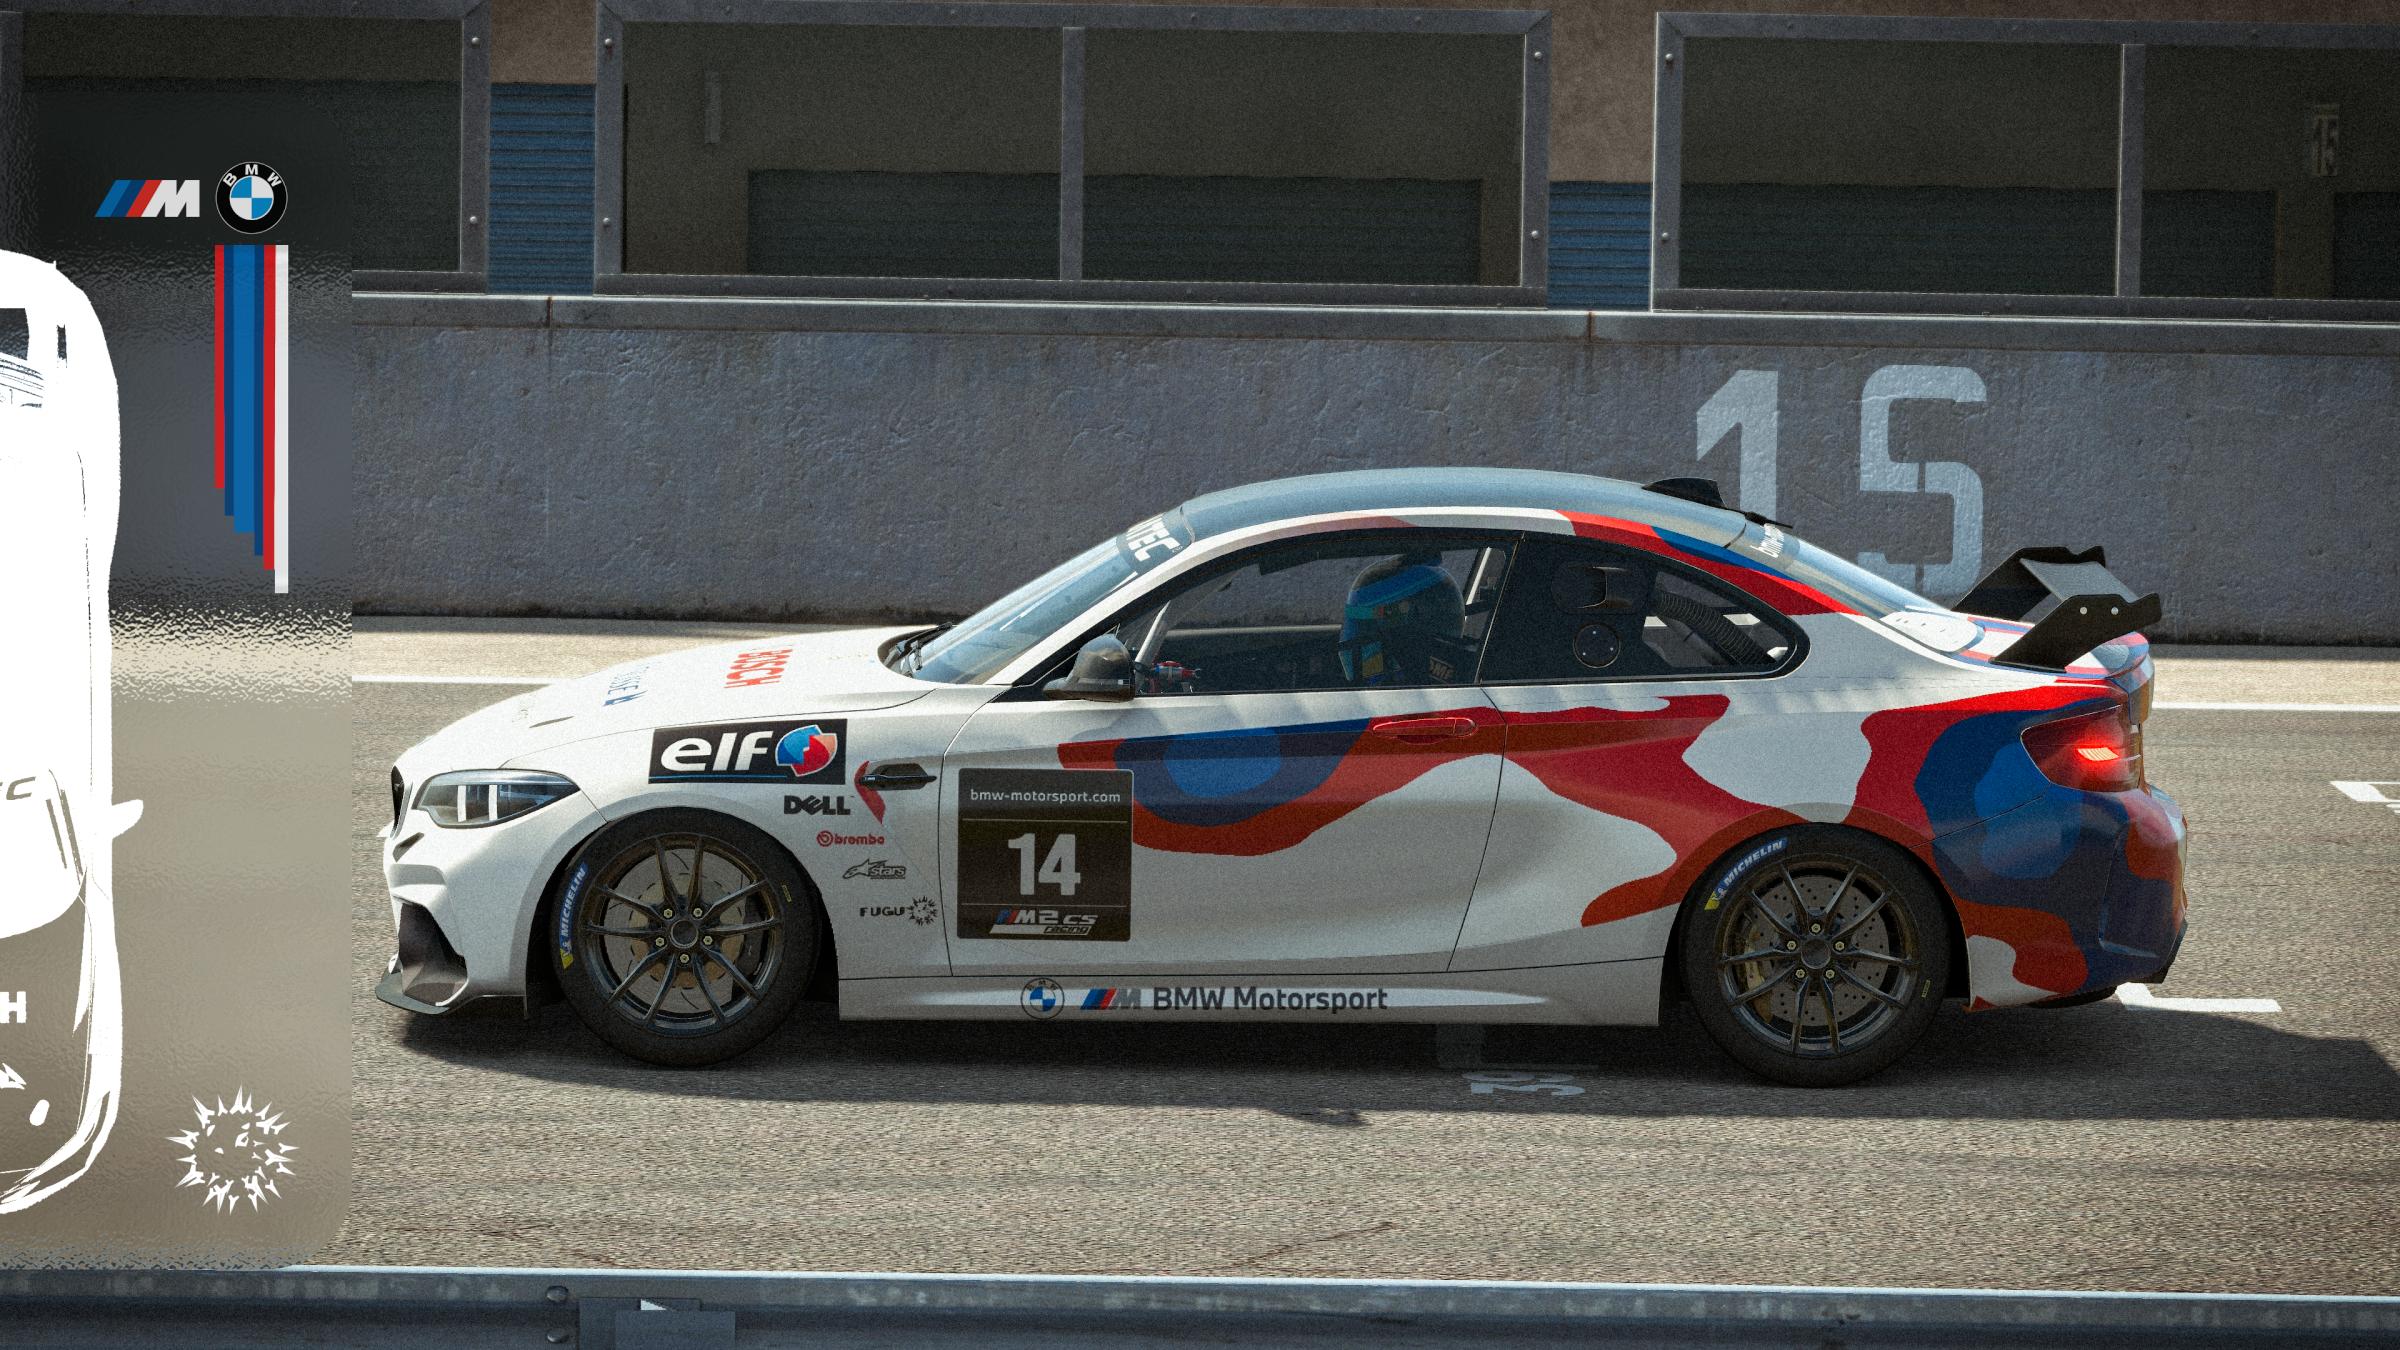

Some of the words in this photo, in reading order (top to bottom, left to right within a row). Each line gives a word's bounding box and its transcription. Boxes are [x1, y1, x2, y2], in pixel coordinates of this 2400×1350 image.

[1696, 364, 1987, 599] 15
[661, 730, 773, 772] elf
[784, 795, 850, 816] DELL
[971, 788, 1121, 804] bmw-motorsport.com
[834, 833, 885, 846] brembo
[1008, 833, 1081, 896] 14
[1723, 839, 1783, 887] MICHELIN
[560, 867, 586, 937] MICHELIN
[860, 906, 905, 917] FUGU
[1153, 986, 1226, 1011] BMW
[1233, 987, 1388, 1015] Motorsport
